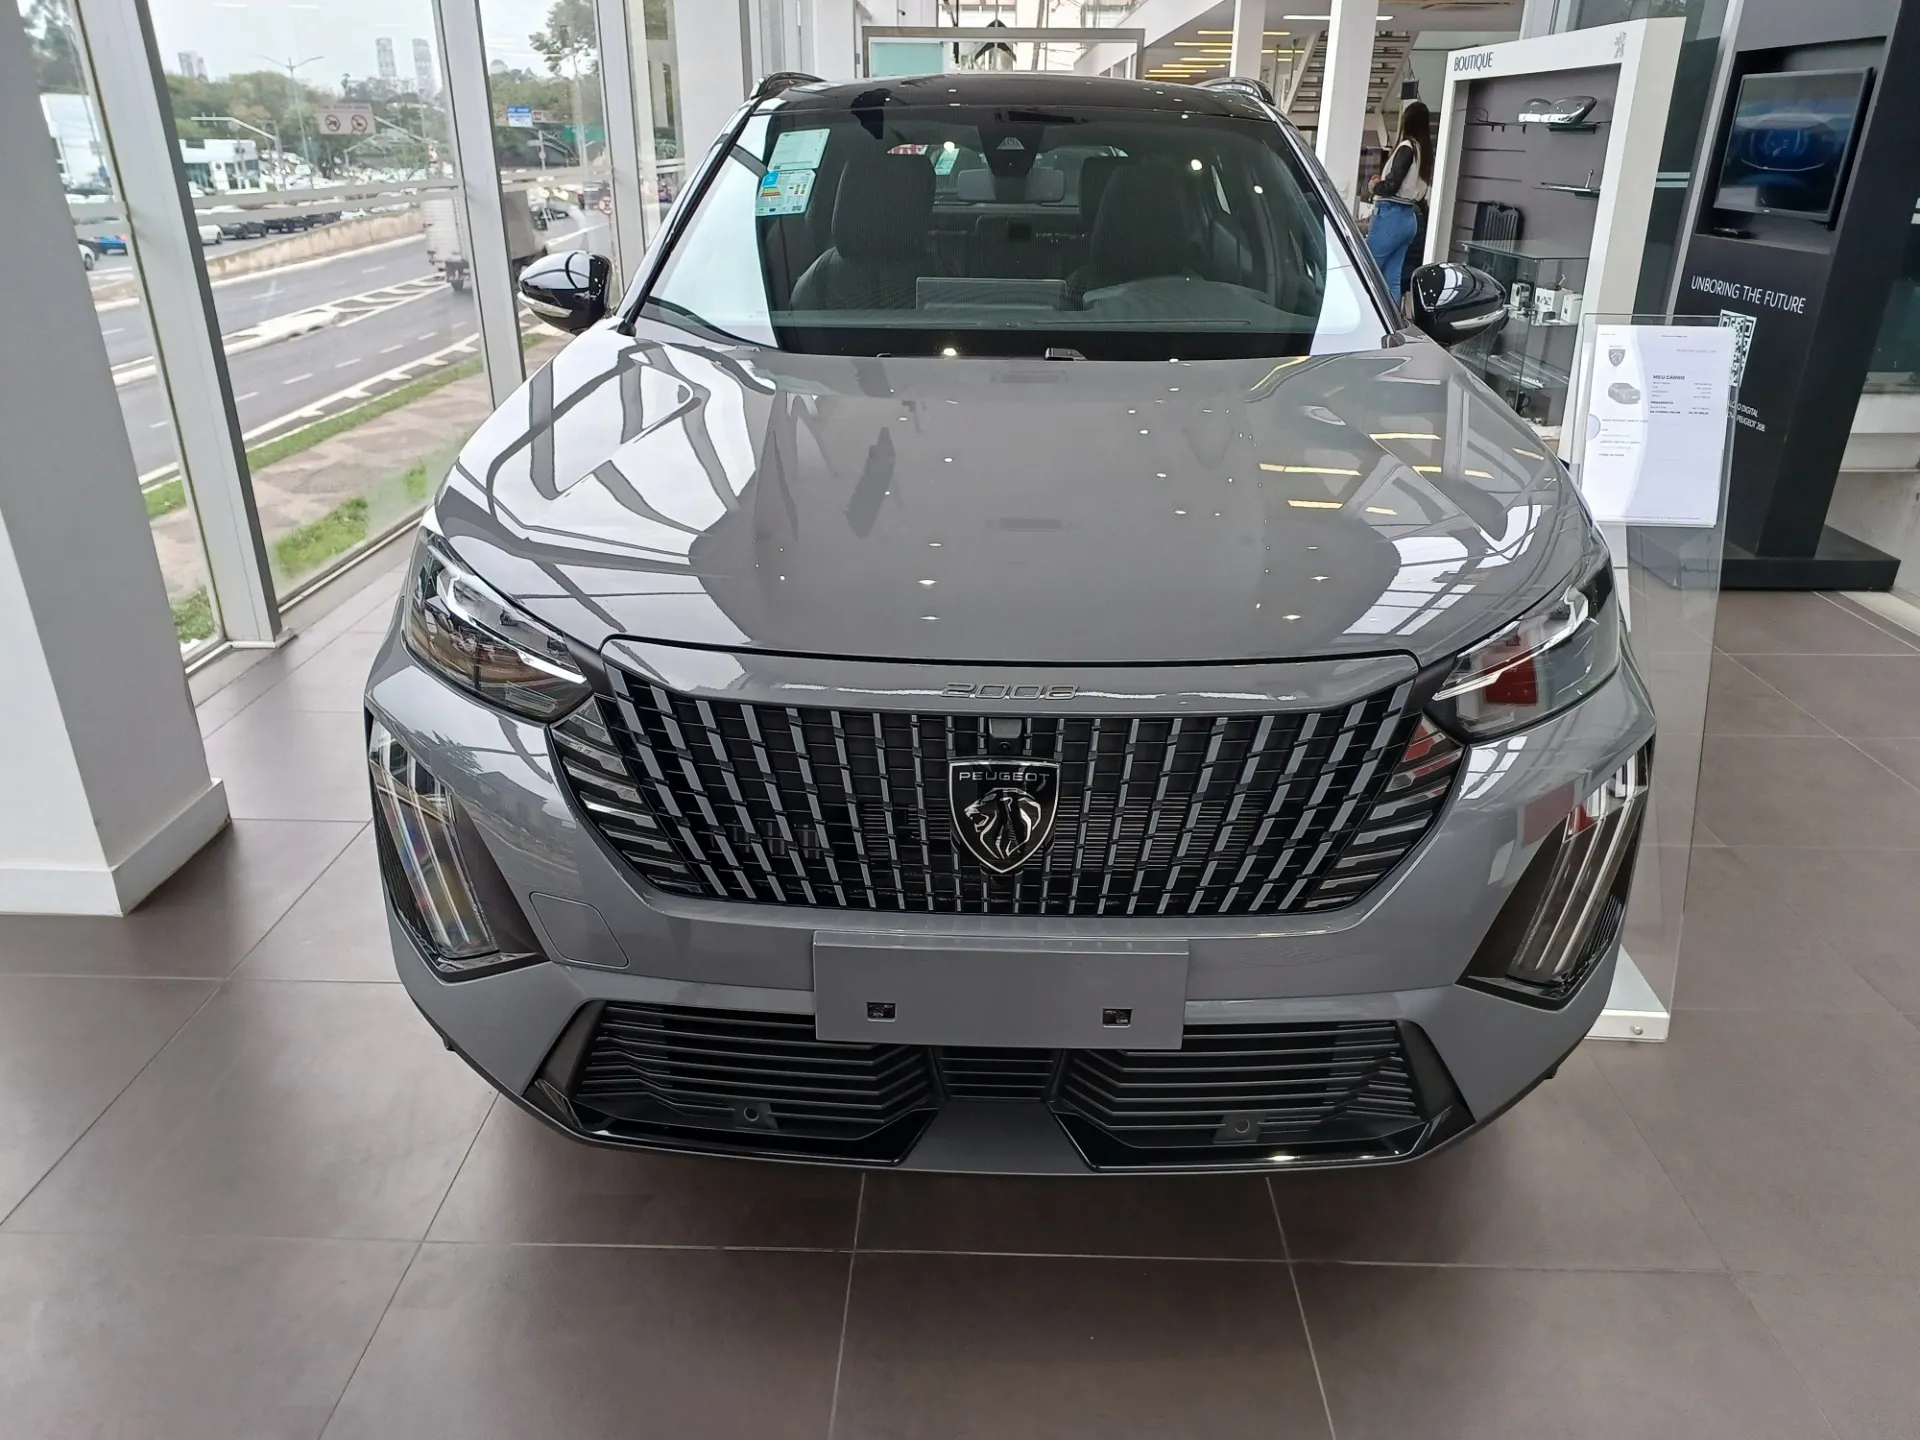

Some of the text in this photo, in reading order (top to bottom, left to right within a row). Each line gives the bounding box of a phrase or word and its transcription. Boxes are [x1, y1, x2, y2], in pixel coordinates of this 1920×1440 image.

[1453, 52, 1494, 71] BOUTIQUE
[1691, 275, 1806, 314] UNBORING THE FUTURE
[1741, 405, 1759, 418] DIGITAL
[1737, 415, 1757, 428] PEUGEOT
[941, 682, 1079, 700] 2008
[959, 771, 1050, 782] PEUGEOT
